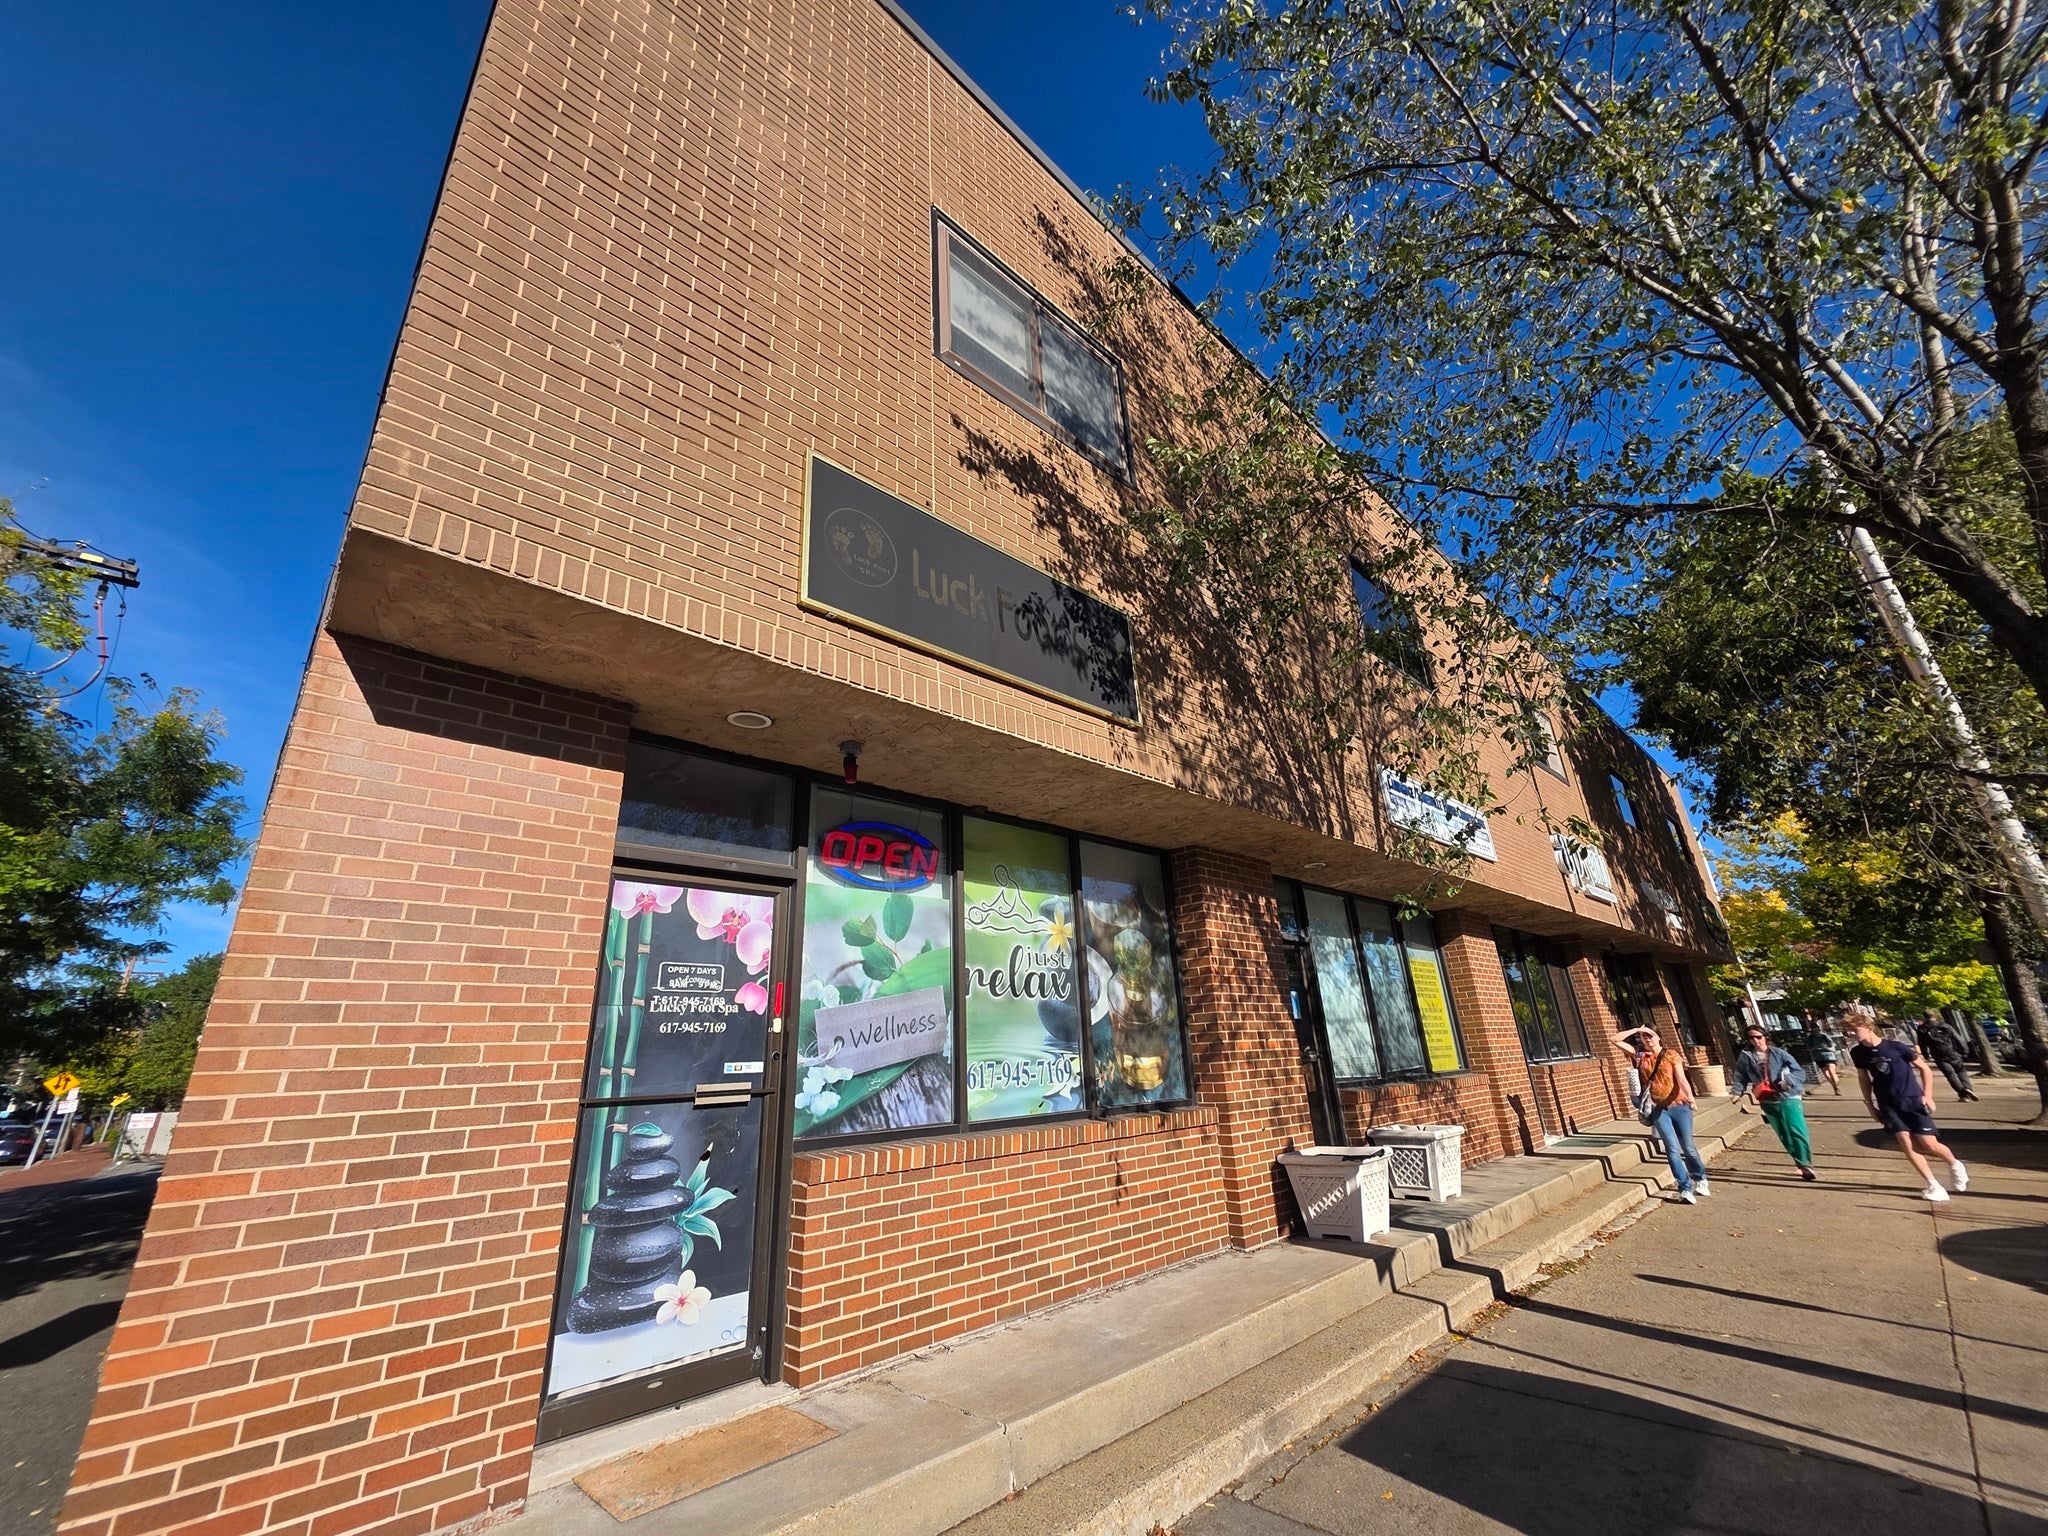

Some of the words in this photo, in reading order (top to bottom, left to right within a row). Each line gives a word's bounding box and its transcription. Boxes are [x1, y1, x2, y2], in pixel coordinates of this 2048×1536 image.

[912, 548, 988, 622] Luck
[820, 829, 940, 882] OPEN
[668, 966, 690, 974] OPEN
[697, 967, 717, 975] DAYS
[965, 944, 1071, 999] relax
[1024, 946, 1068, 972] just
[649, 1000, 687, 1016] Lucky
[690, 1001, 716, 1013] Foot
[717, 1003, 739, 1016] Spa
[659, 1021, 727, 1034] 617-945-7169
[849, 1011, 937, 1051] Wellness
[966, 1058, 1073, 1090] 617-945-7169
